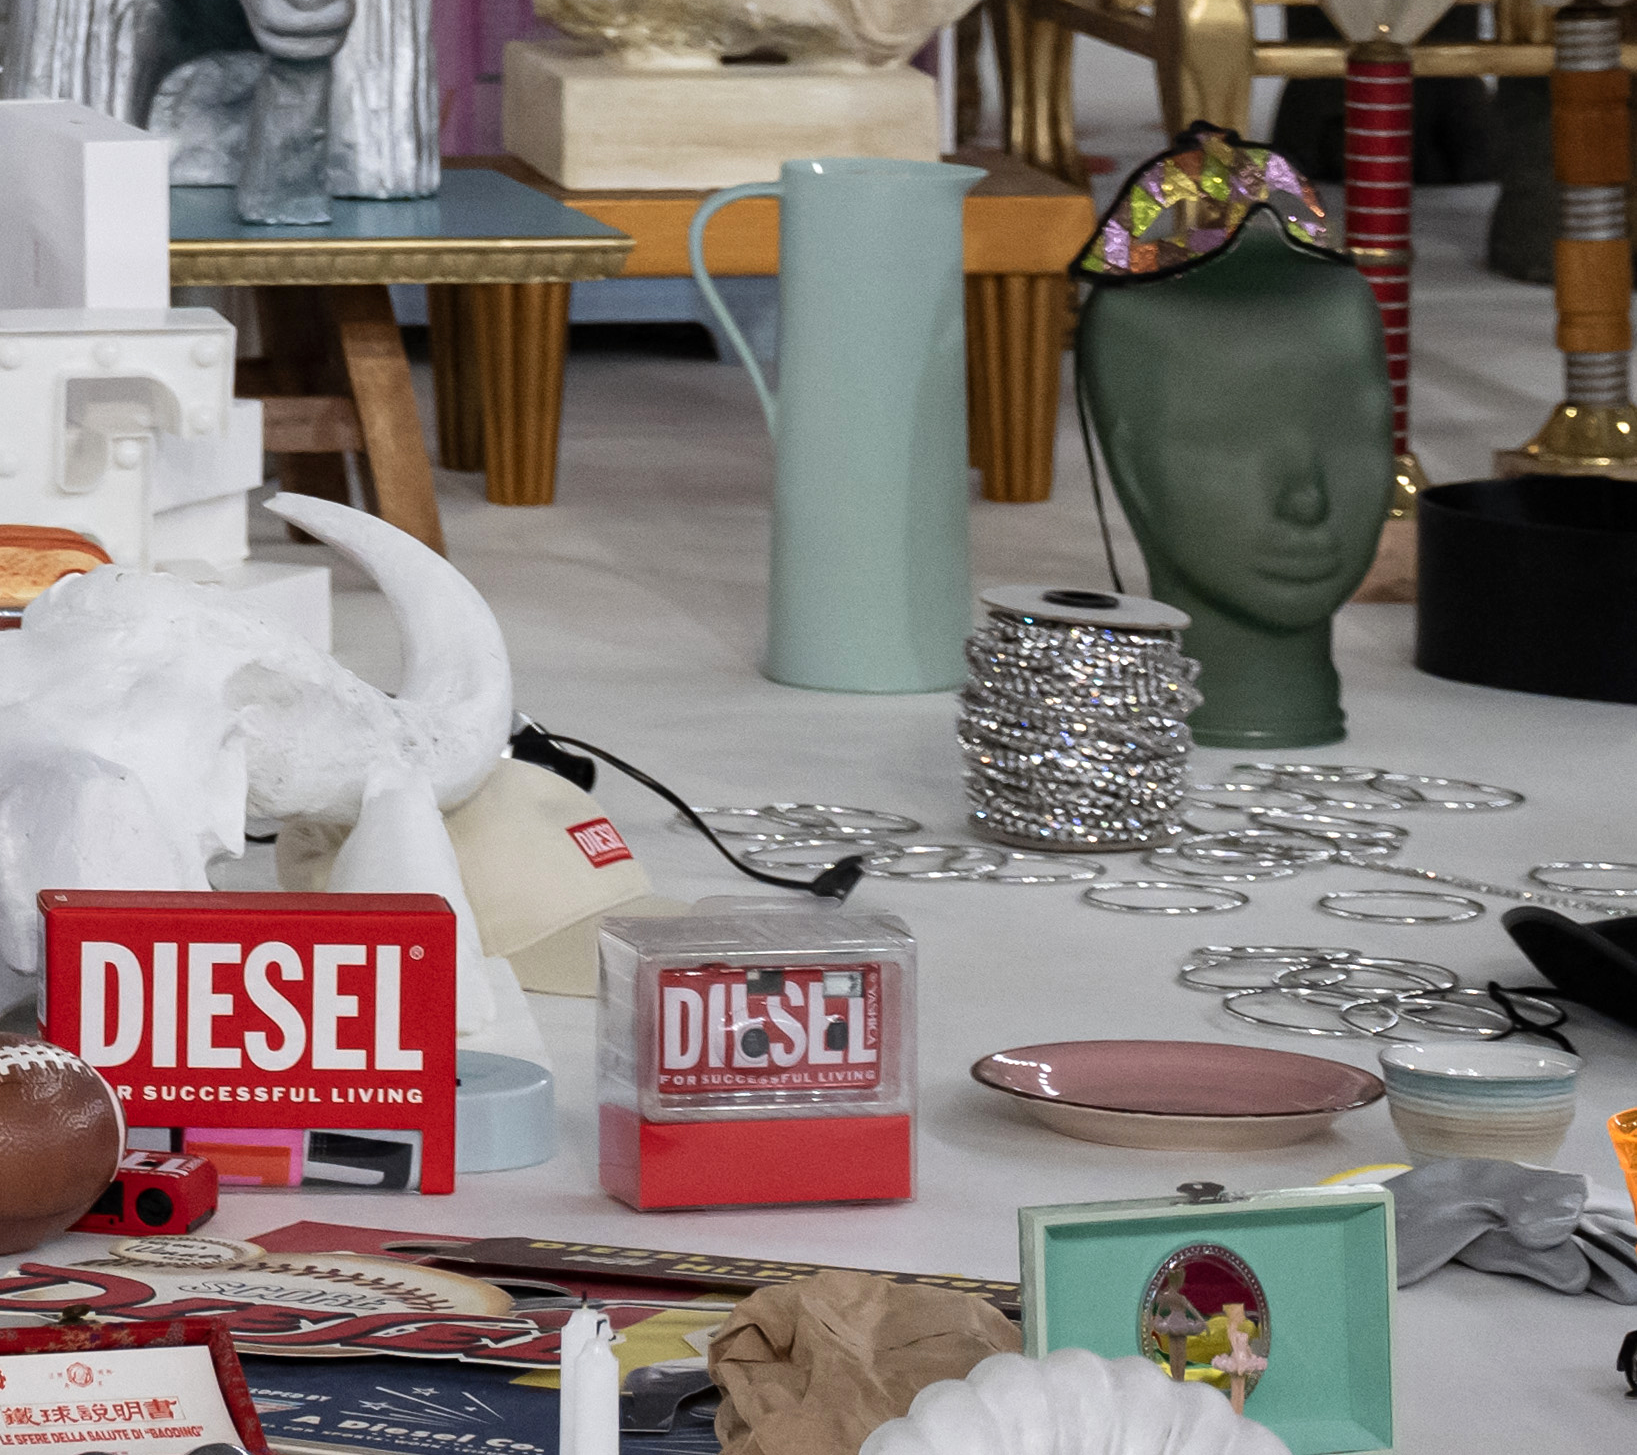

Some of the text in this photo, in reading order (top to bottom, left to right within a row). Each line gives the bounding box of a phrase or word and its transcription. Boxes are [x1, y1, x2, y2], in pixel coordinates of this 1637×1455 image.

[79, 940, 424, 1072] DIESEL
[663, 981, 877, 1070] DIESEL
[659, 1074, 697, 1086] FOR
[817, 1069, 877, 1082] LIVING
[142, 1085, 322, 1103] SUCCESSFUL
[331, 1088, 424, 1105] LIVING
[0, 1434, 14, 1445] LE
[14, 1433, 51, 1445] SFERE
[51, 1431, 88, 1444] DELLA
[88, 1430, 130, 1442] SALUTE
[130, 1428, 144, 1440] DI
